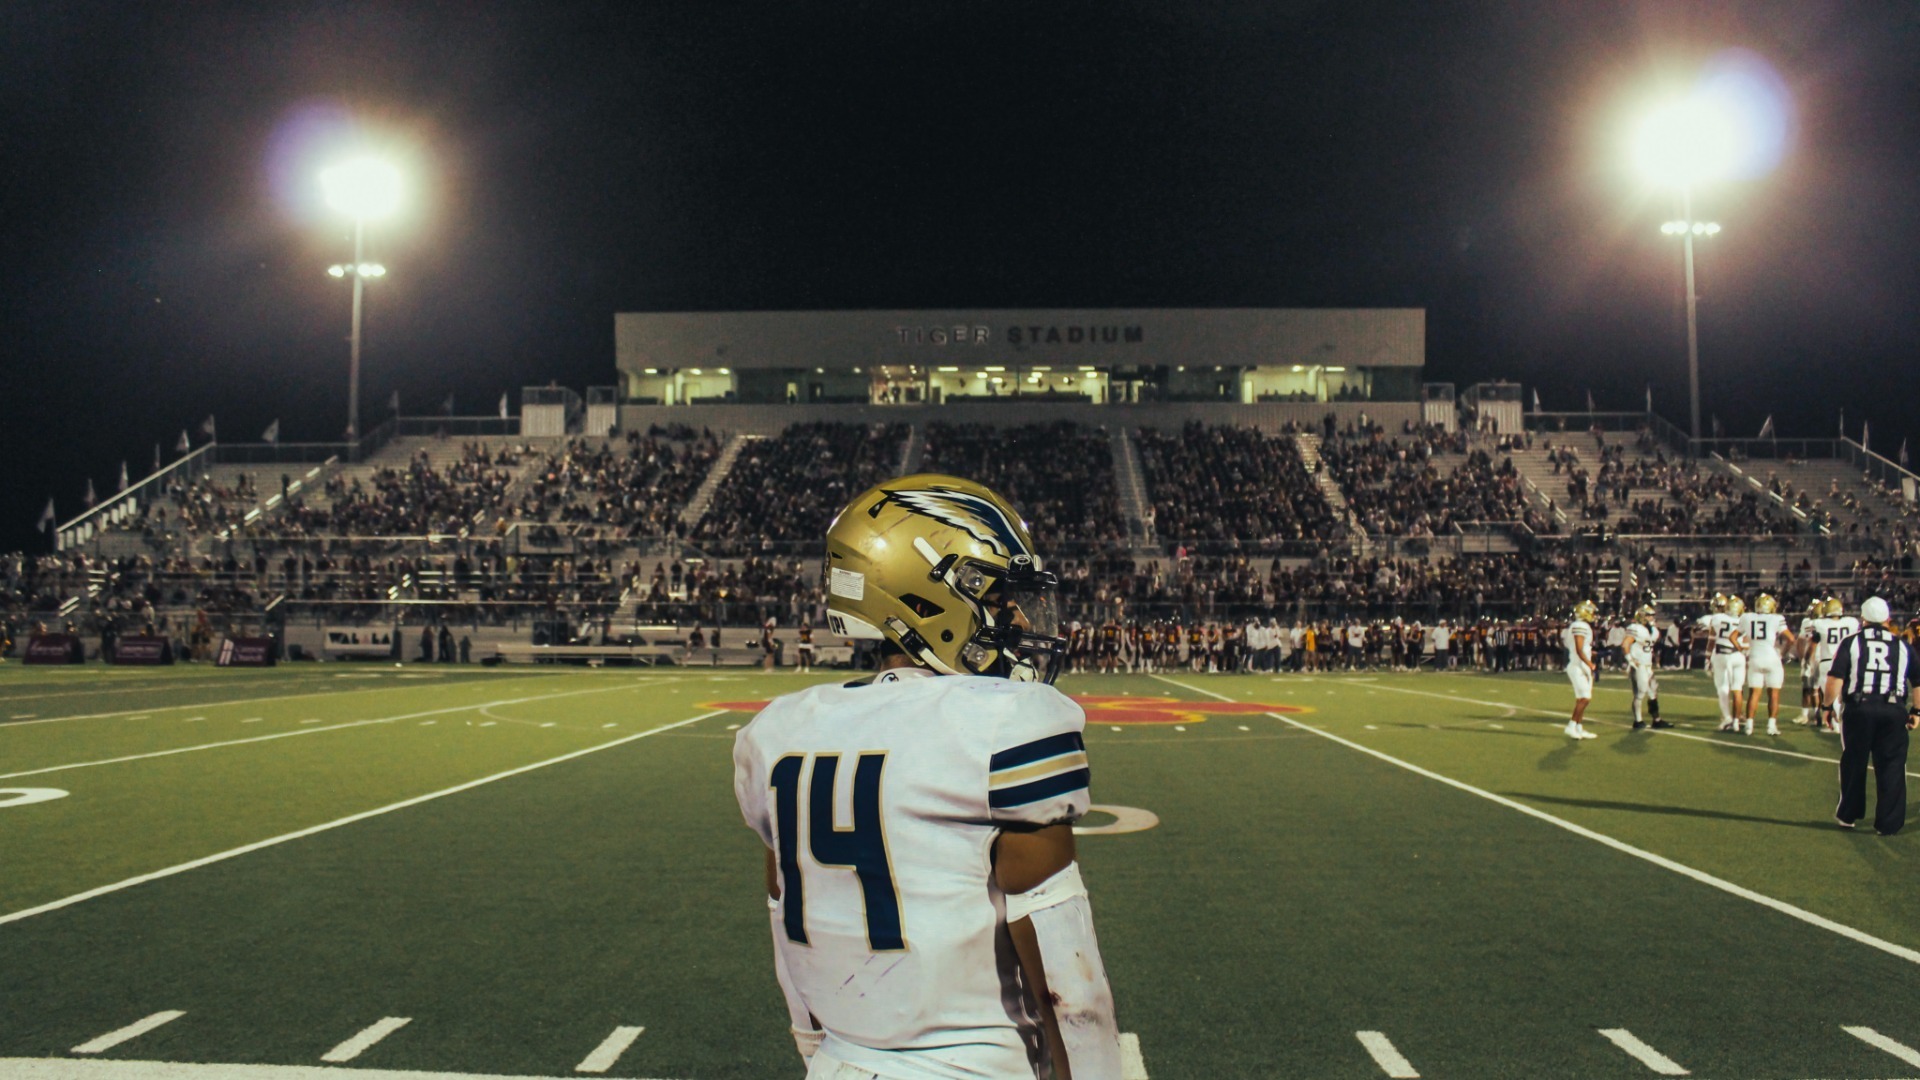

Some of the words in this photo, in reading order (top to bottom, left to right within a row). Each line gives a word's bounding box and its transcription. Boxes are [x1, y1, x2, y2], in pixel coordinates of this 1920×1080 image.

[896, 325, 990, 344] TIGER
[1007, 325, 1143, 343] STADIUM
[1750, 620, 1767, 640] 13
[1866, 641, 1891, 671] R
[769, 750, 910, 953] 14
